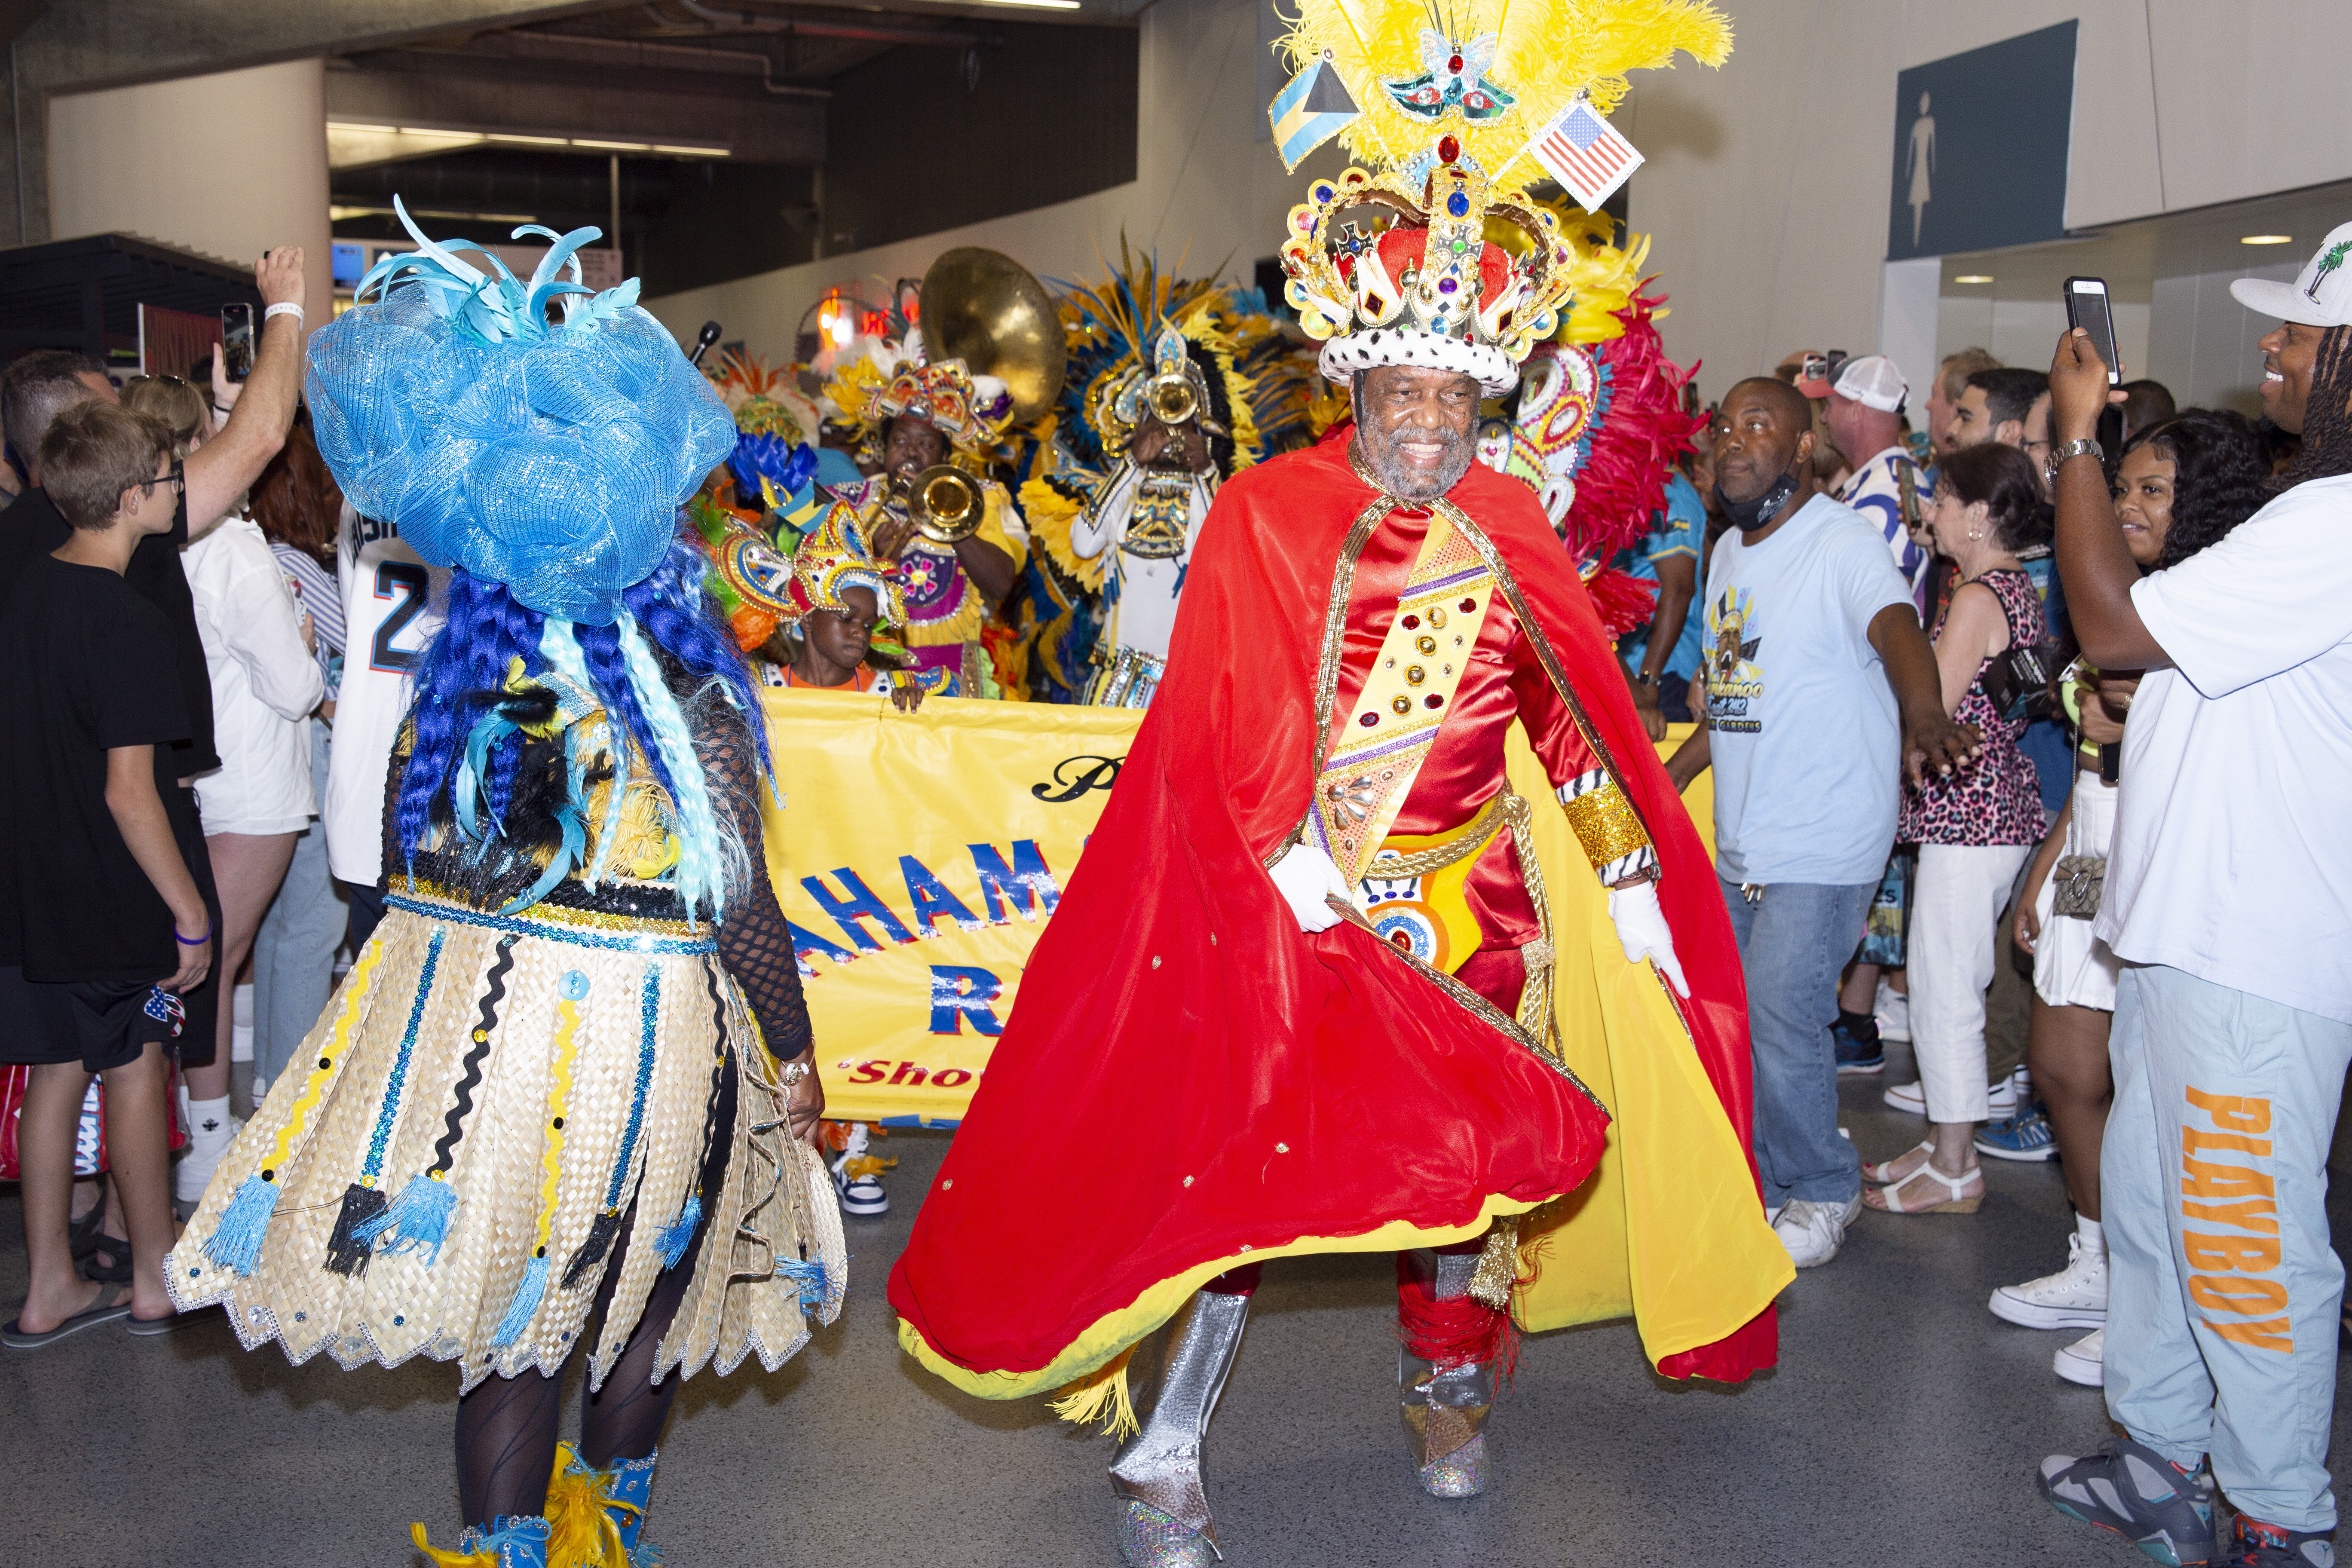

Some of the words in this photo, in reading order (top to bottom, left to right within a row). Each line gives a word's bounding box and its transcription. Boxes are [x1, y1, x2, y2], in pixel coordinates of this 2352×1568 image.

[369, 560, 430, 675] 2
[787, 835, 1092, 981] AHAM
[928, 965, 1025, 1037] R
[2181, 1084, 2294, 1354] PLAYBOY
